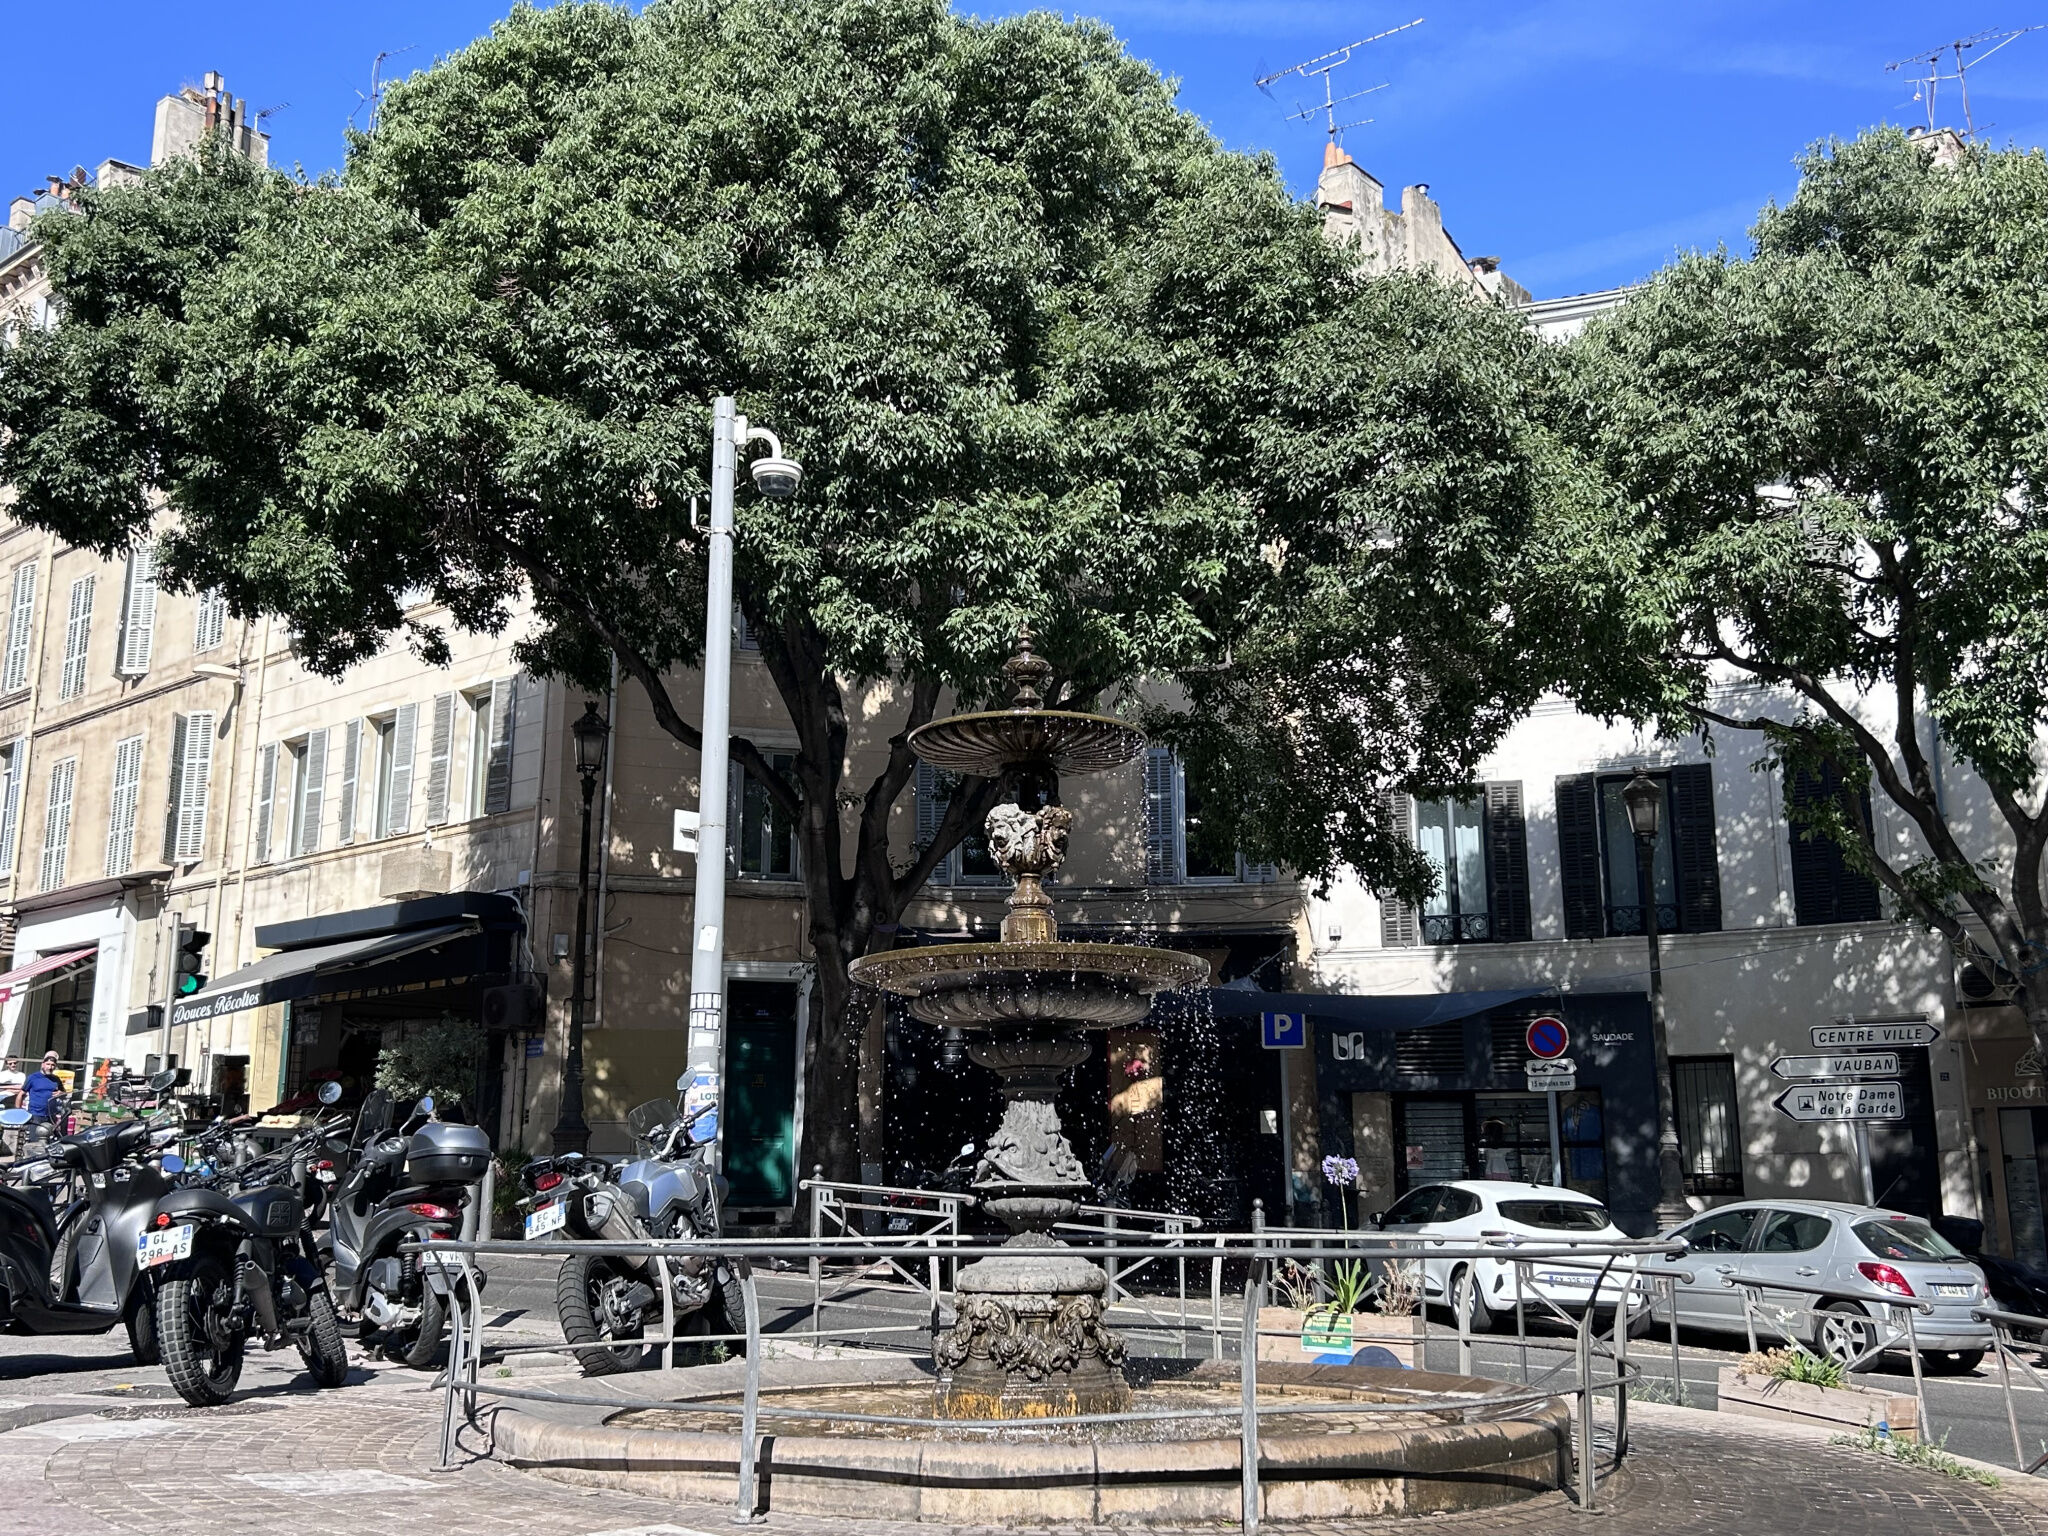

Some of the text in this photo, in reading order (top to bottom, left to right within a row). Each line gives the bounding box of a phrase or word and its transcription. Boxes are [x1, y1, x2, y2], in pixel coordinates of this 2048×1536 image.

[173, 990, 260, 1024] Douces Récoltes
[1274, 1014, 1293, 1040] P
[1592, 1032, 1635, 1042] SAUDADE
[1818, 1028, 1923, 1043] CENTRE VILLE
[1834, 1061, 1893, 1072] VAUBAN
[1818, 1089, 1896, 1102] Notre Dame
[1820, 1103, 1896, 1115] de la Garde
